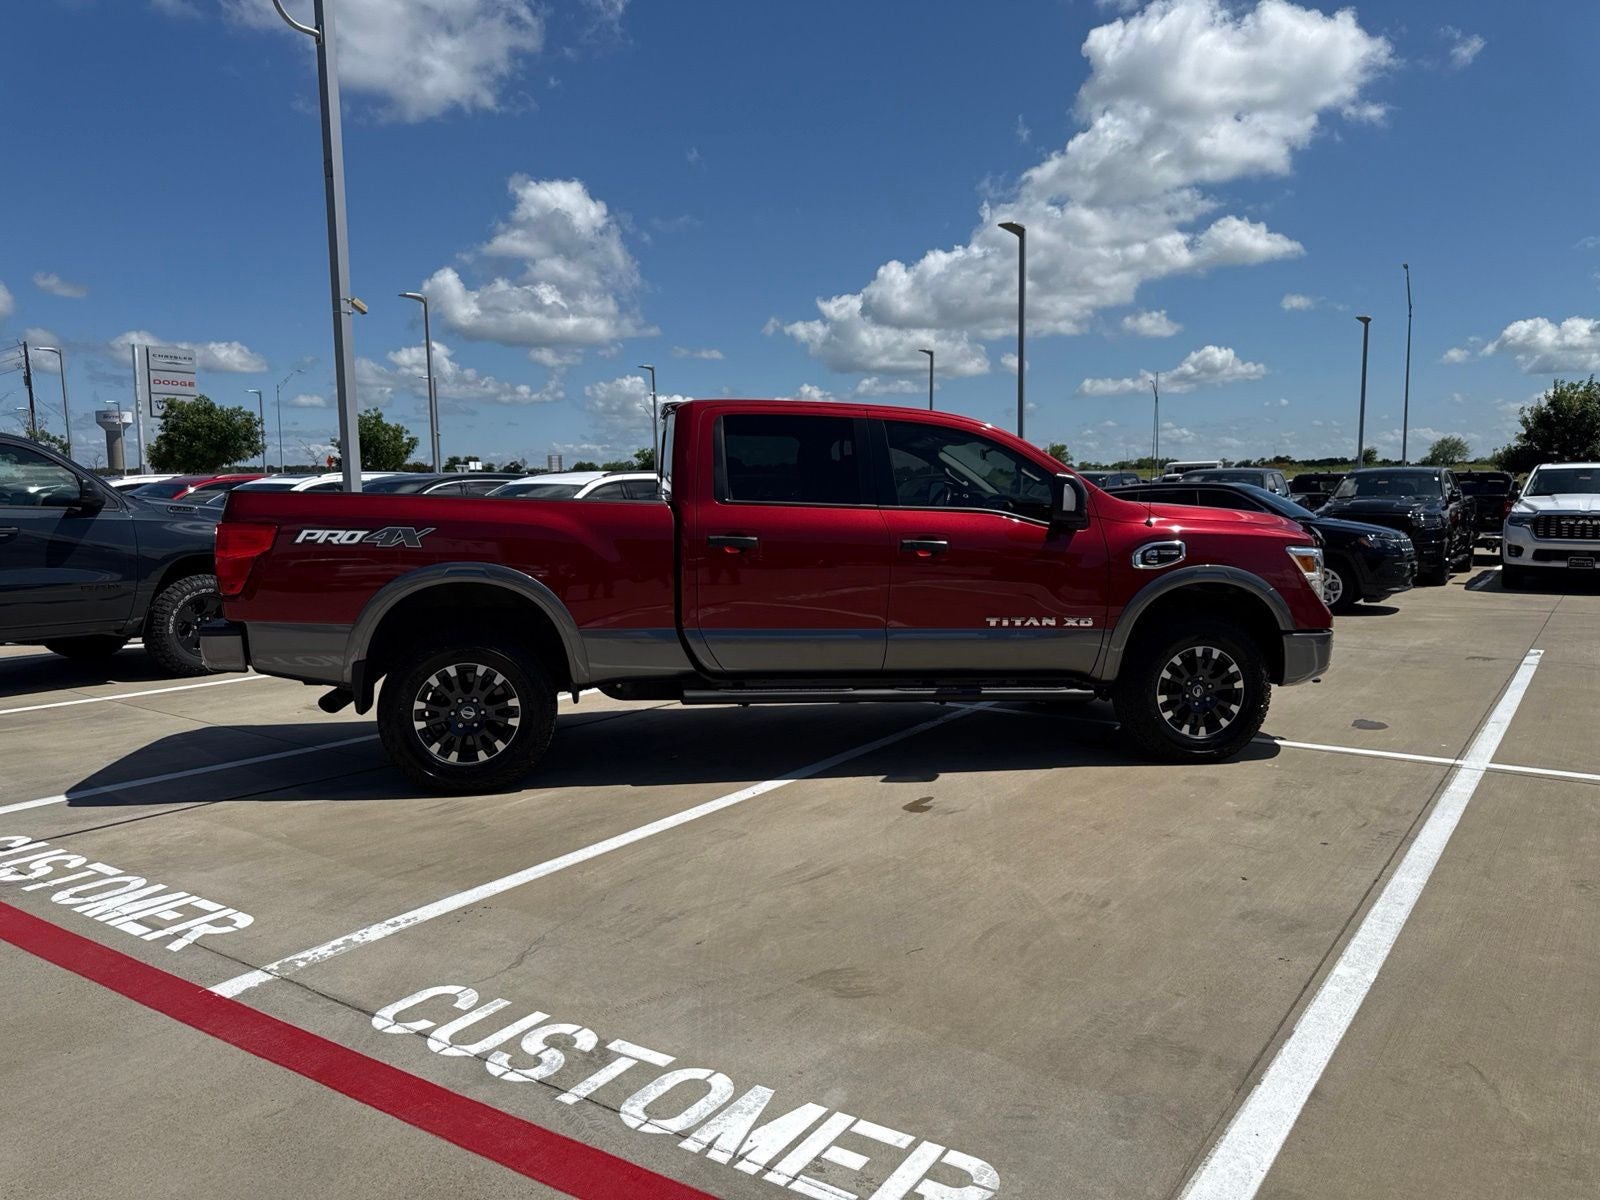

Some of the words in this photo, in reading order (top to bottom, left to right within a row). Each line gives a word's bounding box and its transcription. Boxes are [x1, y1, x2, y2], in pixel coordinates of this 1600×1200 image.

[153, 379, 195, 388] DODGE
[985, 617, 1056, 627] TITAN
[1063, 617, 1094, 627] XD
[371, 985, 1000, 1200] CUSTOMER
